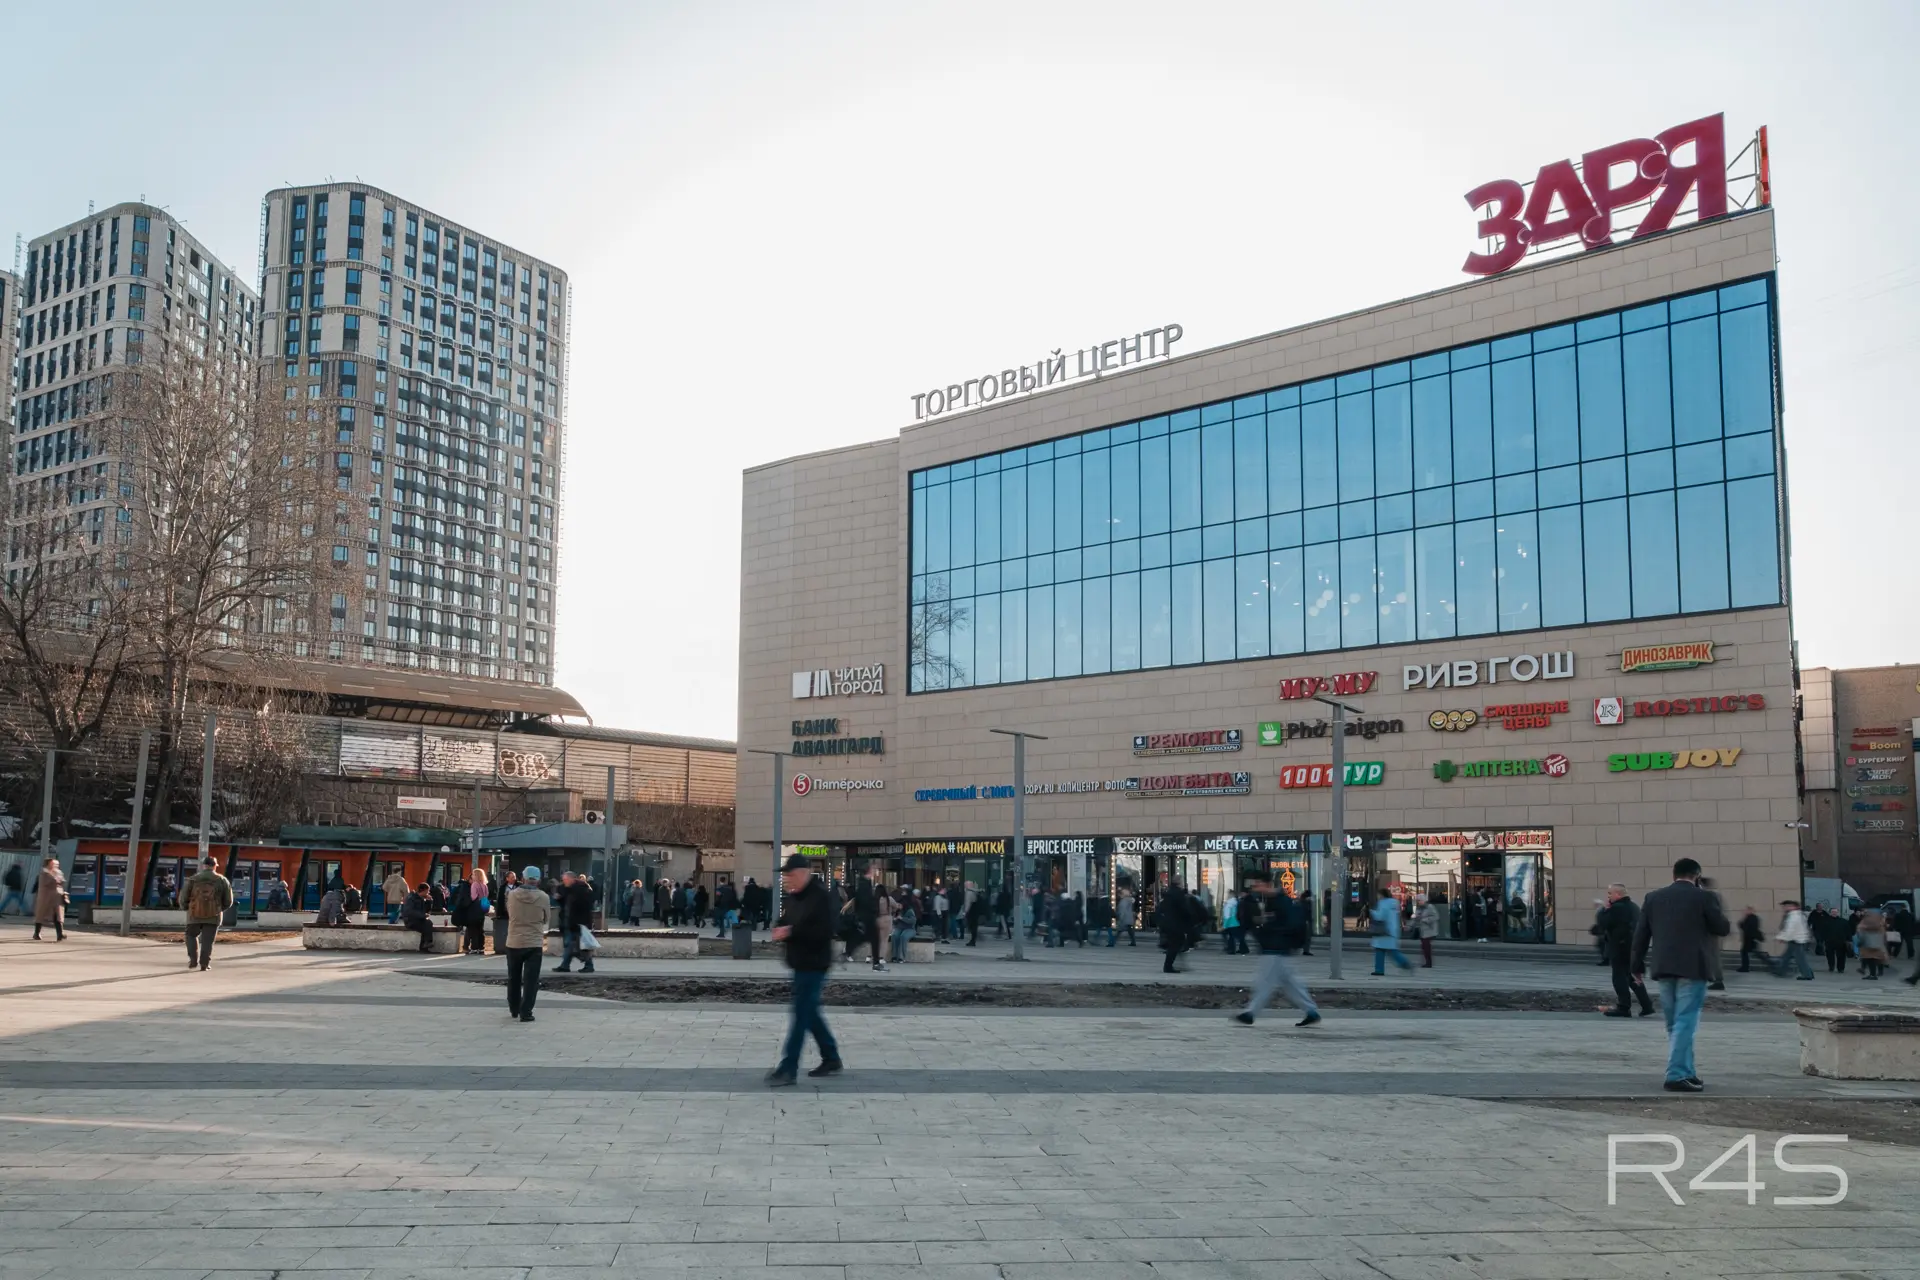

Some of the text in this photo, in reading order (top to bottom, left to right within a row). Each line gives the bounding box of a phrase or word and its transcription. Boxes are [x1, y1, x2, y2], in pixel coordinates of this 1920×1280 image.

[1461, 111, 1729, 277] ЗАРЯ
[911, 323, 1183, 420] ТОРГОВЫЙ ЦЕНТР
[1623, 643, 1711, 668] ДИНОЗАВРИК
[834, 662, 884, 681] ЧИТАЙ
[1403, 650, 1574, 691] РИВ ГОШ
[834, 679, 884, 695] ГОРОД
[1484, 700, 1570, 718] СМЕШНЫЕ
[1633, 694, 1766, 717] ROSTIC'S
[792, 718, 839, 736] БАНК
[1343, 717, 1404, 740] aigon
[1503, 715, 1551, 731] ЦЕНЫ
[792, 737, 885, 755] АВАНГАРД
[1148, 730, 1224, 748] РЕМОНТ
[1463, 759, 1541, 777] АПТЕКА
[1549, 763, 1567, 774] №1
[1608, 748, 1742, 772] SUBJOY
[813, 779, 884, 793] Пятёрочка
[1058, 780, 1100, 794] КОПИЦЕНТР
[1141, 772, 1234, 790] ДОМ БЫТА
[905, 842, 947, 854] ШАУРМА
[956, 840, 1005, 854] НАПИТКИ
[1034, 839, 1095, 854] PRICE COFFEE
[1233, 840, 1259, 850] TEA
[1347, 835, 1363, 850] t2
[1417, 836, 1469, 845] ПАША
[796, 845, 829, 856] ТАБАК
